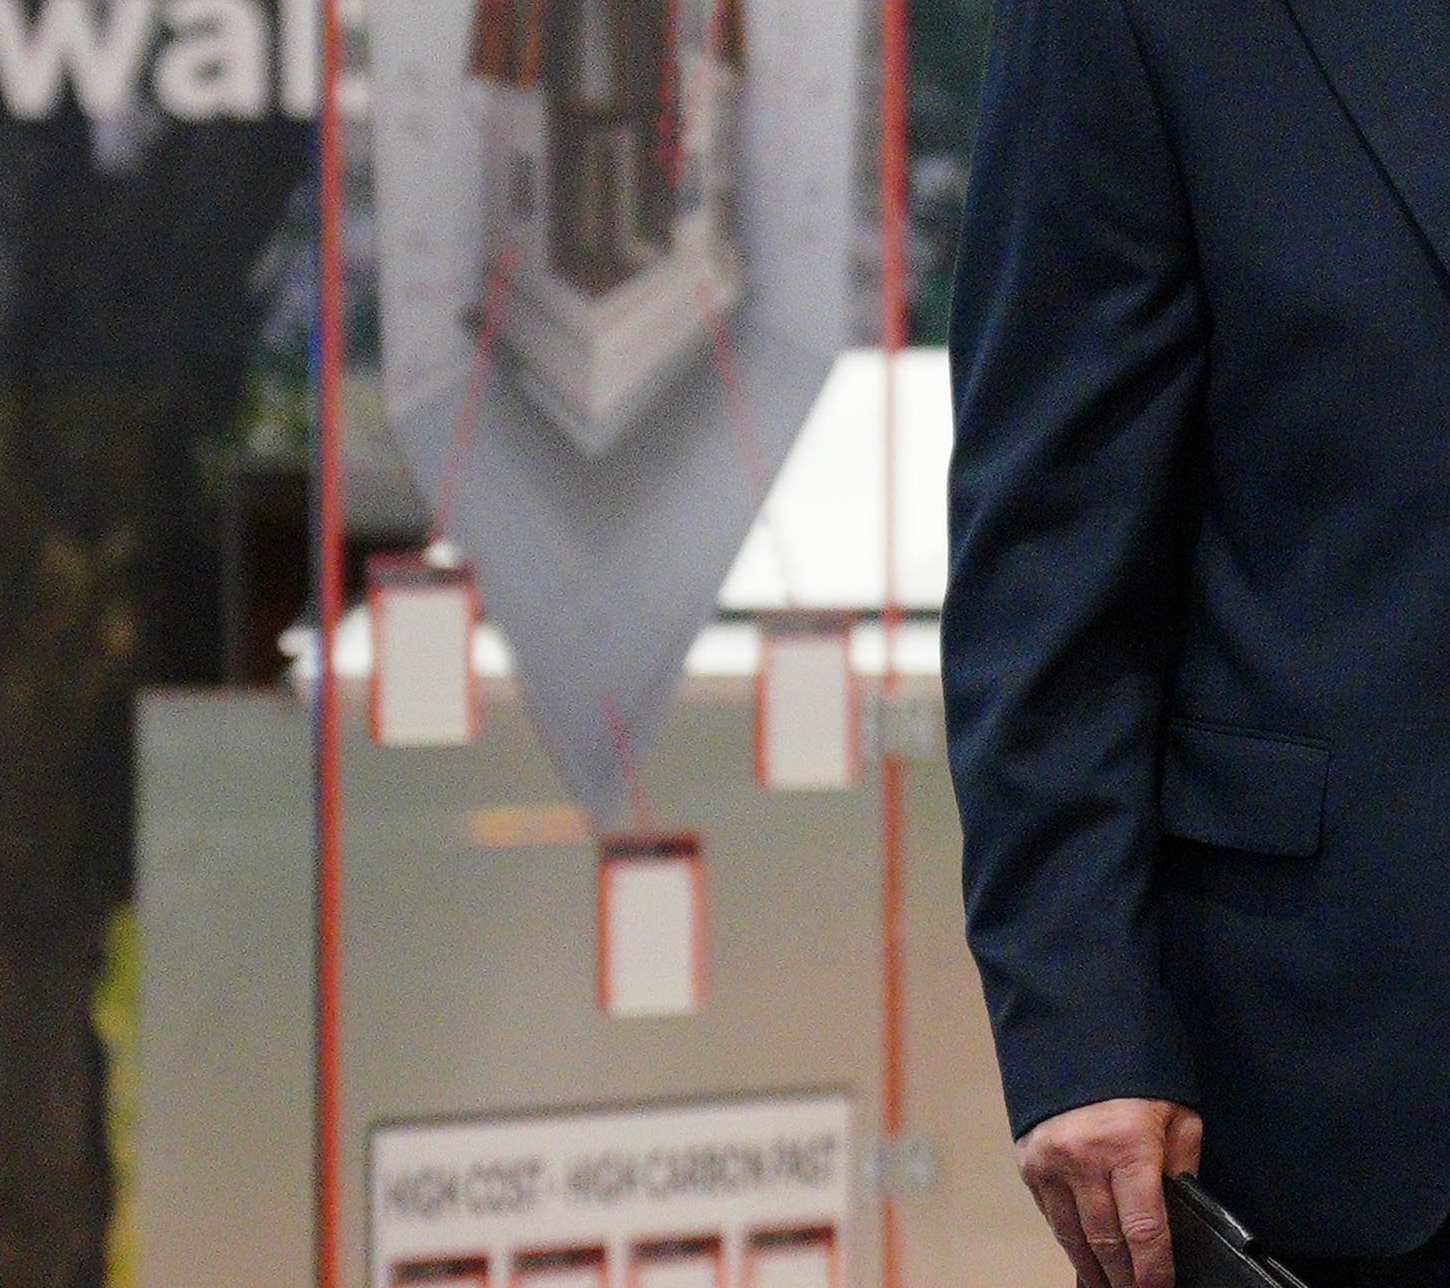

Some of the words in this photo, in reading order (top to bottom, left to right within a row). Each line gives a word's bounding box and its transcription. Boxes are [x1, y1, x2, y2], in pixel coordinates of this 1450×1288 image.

[386, 1164, 458, 1217] HIGH
[466, 1155, 542, 1215] COST
[567, 1150, 637, 1205] HIGH
[641, 1140, 767, 1201] CARBON
